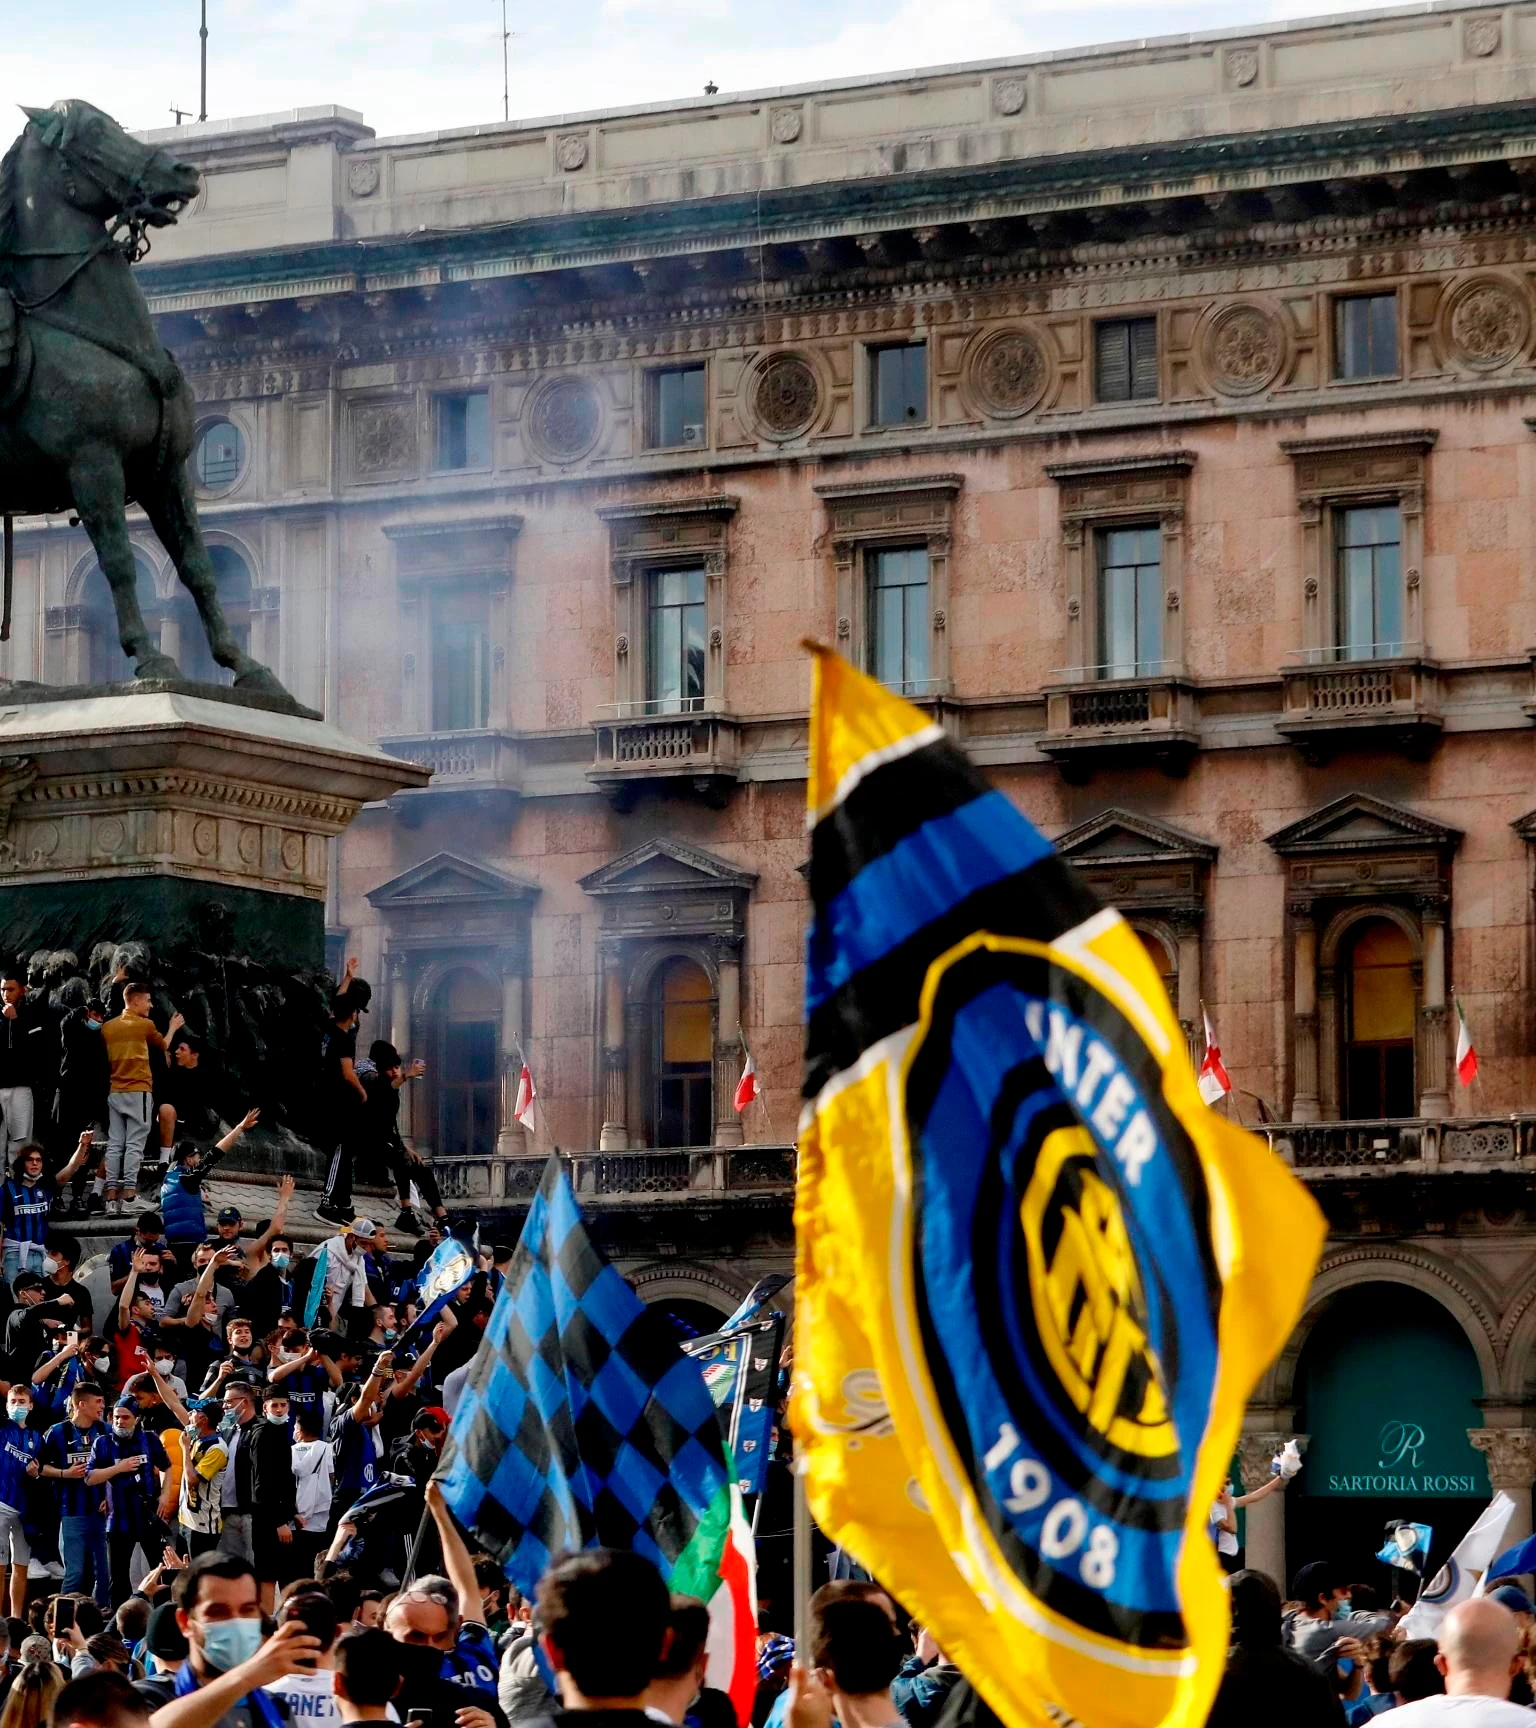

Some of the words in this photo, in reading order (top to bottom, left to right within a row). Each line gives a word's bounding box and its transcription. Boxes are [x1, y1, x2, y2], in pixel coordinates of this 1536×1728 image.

[983, 1421, 1121, 1590] 1908
[1329, 1475, 1417, 1491] SARTORIA
[1423, 1475, 1475, 1491] ROSSI
